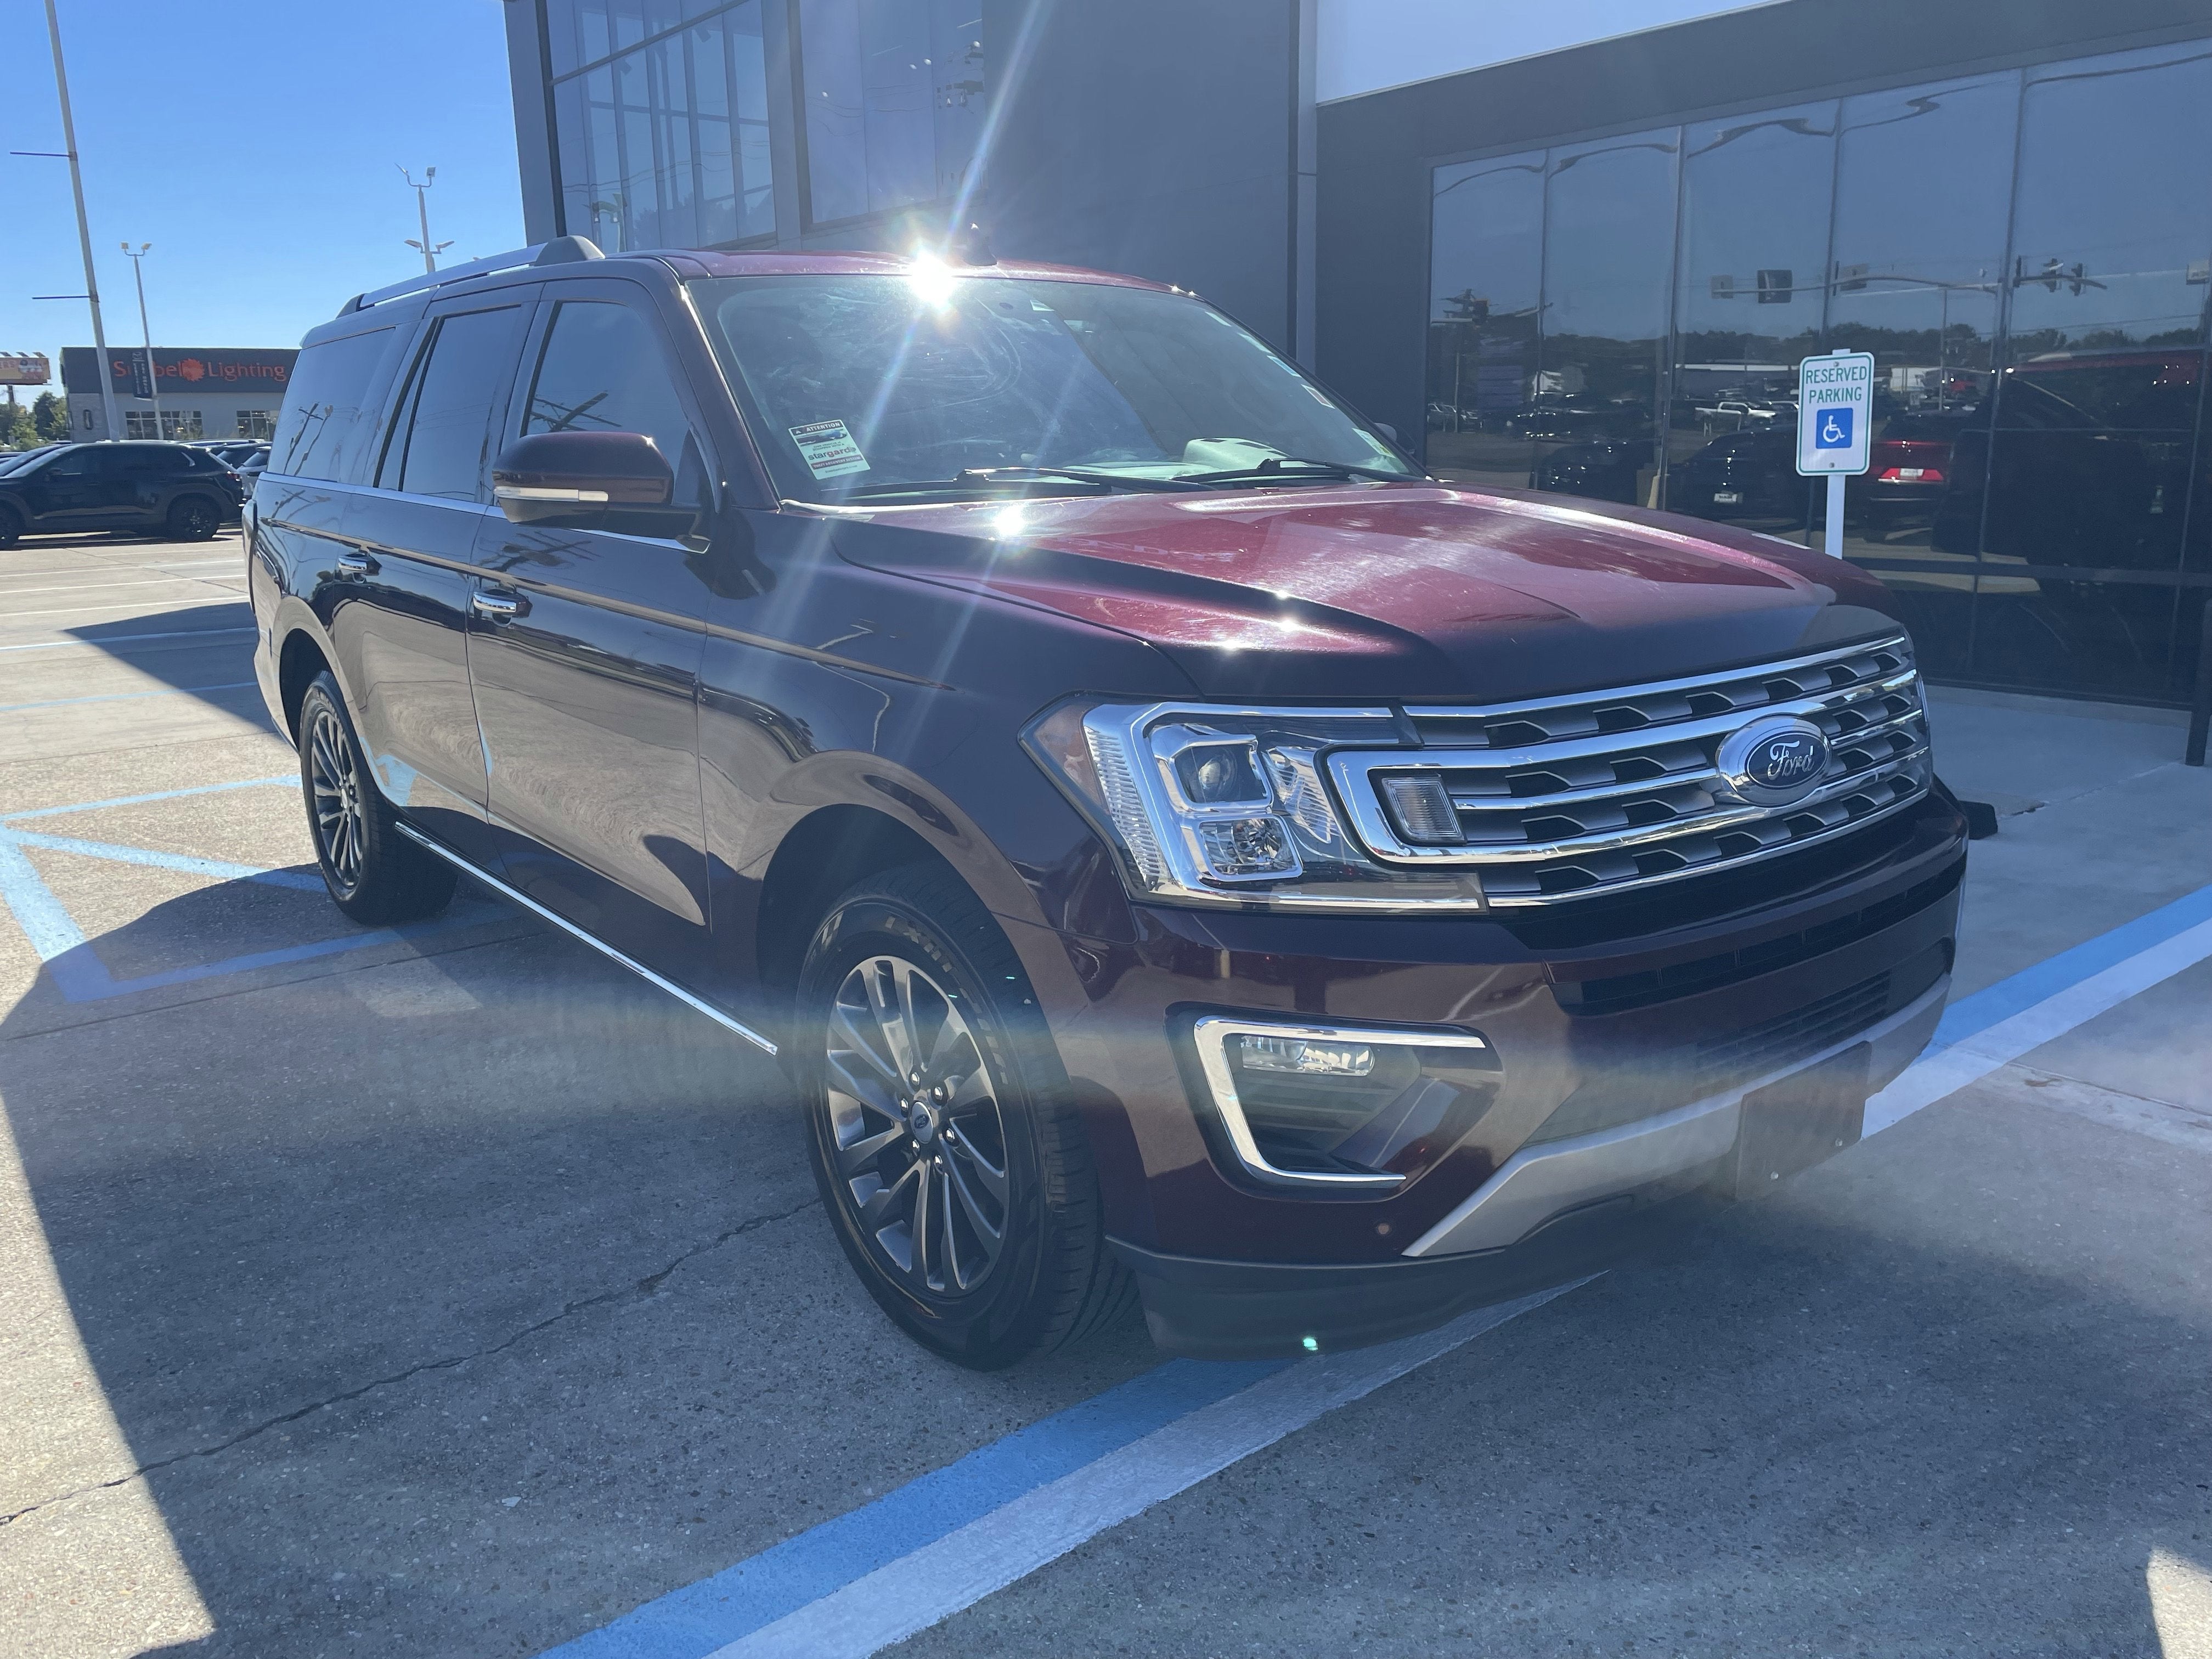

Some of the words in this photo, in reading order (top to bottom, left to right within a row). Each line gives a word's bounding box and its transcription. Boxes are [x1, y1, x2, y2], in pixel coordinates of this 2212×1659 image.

[207, 362, 287, 382] Lighting
[1805, 366, 1867, 384] RESERVED
[1809, 387, 1862, 404] PARKING
[806, 422, 840, 432] ATTENTION
[1767, 740, 1814, 781] Ford
